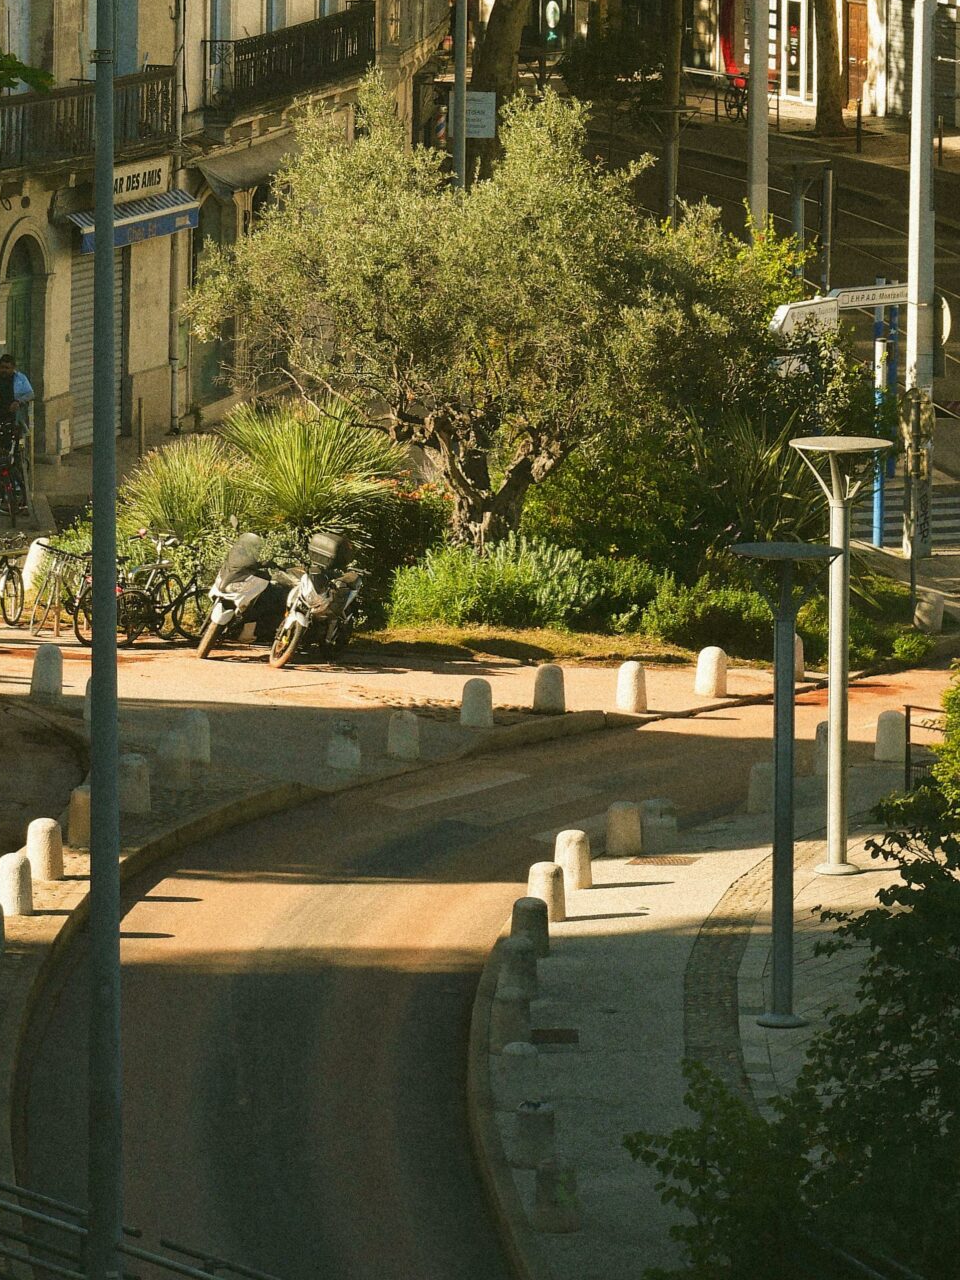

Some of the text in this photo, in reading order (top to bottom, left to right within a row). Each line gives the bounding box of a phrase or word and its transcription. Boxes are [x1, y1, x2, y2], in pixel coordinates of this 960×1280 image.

[113, 168, 161, 195] AR DES AMIS
